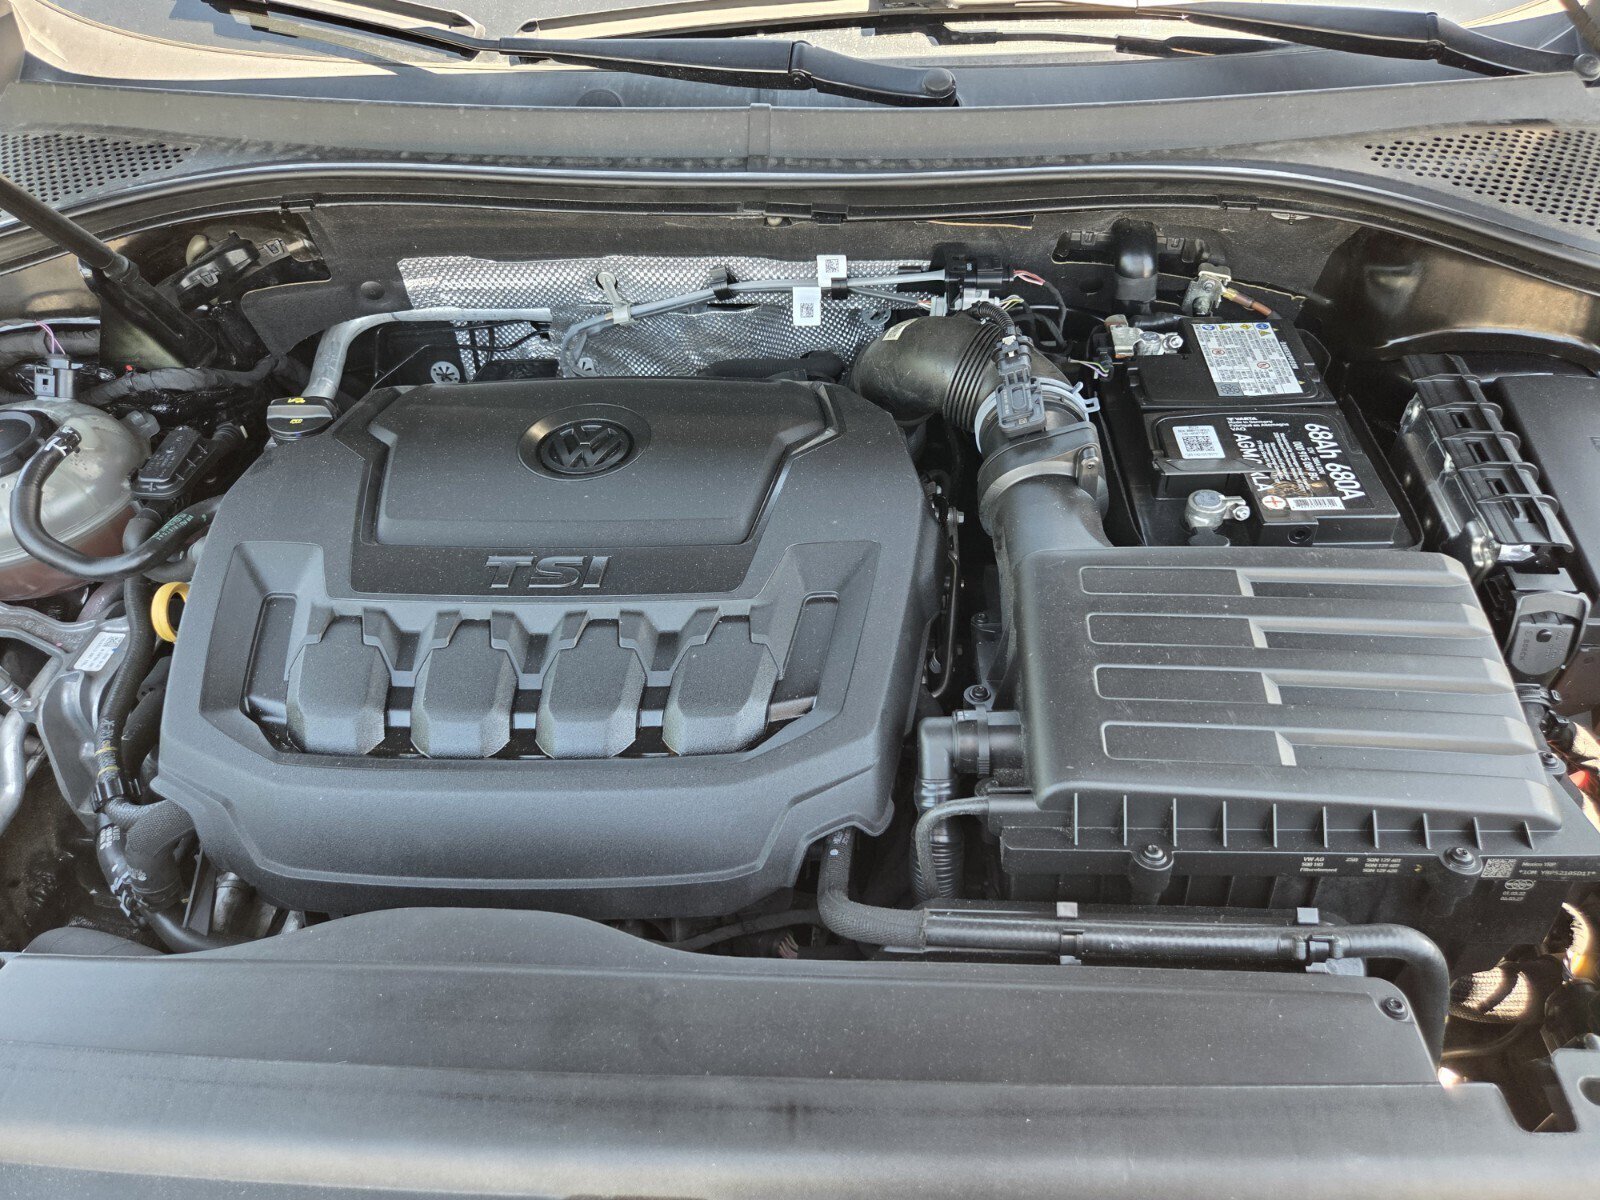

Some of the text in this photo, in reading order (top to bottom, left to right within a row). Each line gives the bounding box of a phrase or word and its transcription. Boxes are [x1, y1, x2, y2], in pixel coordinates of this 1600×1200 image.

[1304, 423, 1365, 500] 68Ah 680A
[486, 555, 613, 589] TSI
